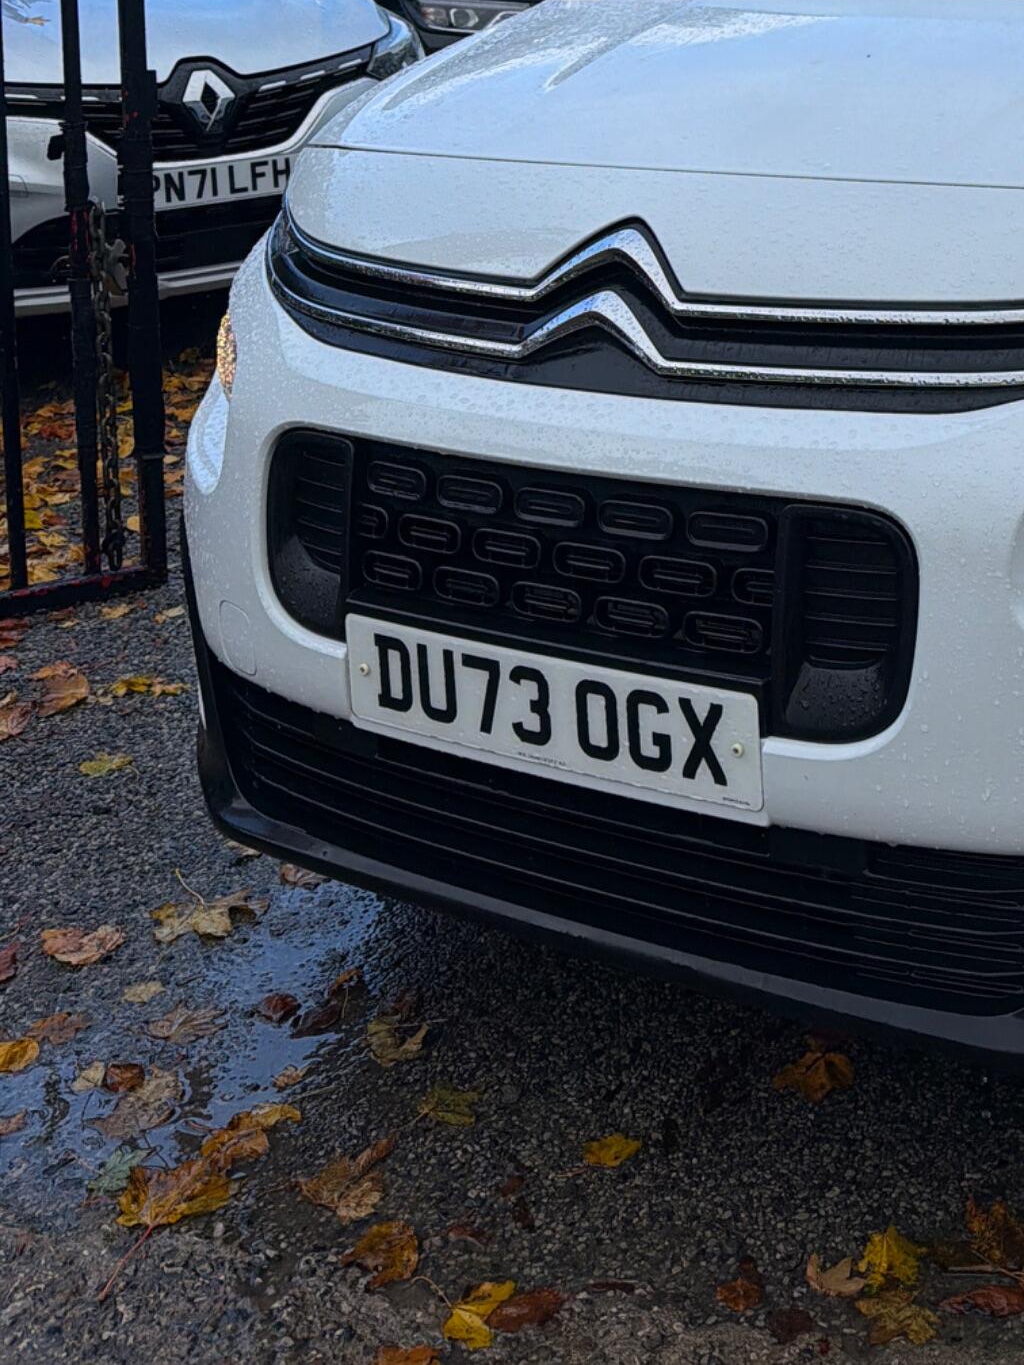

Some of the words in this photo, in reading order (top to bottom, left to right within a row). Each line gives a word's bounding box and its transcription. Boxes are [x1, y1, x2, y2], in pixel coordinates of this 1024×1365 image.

[228, 157, 290, 194] LFH
[373, 633, 552, 746] DU73
[575, 679, 728, 787] OGX
